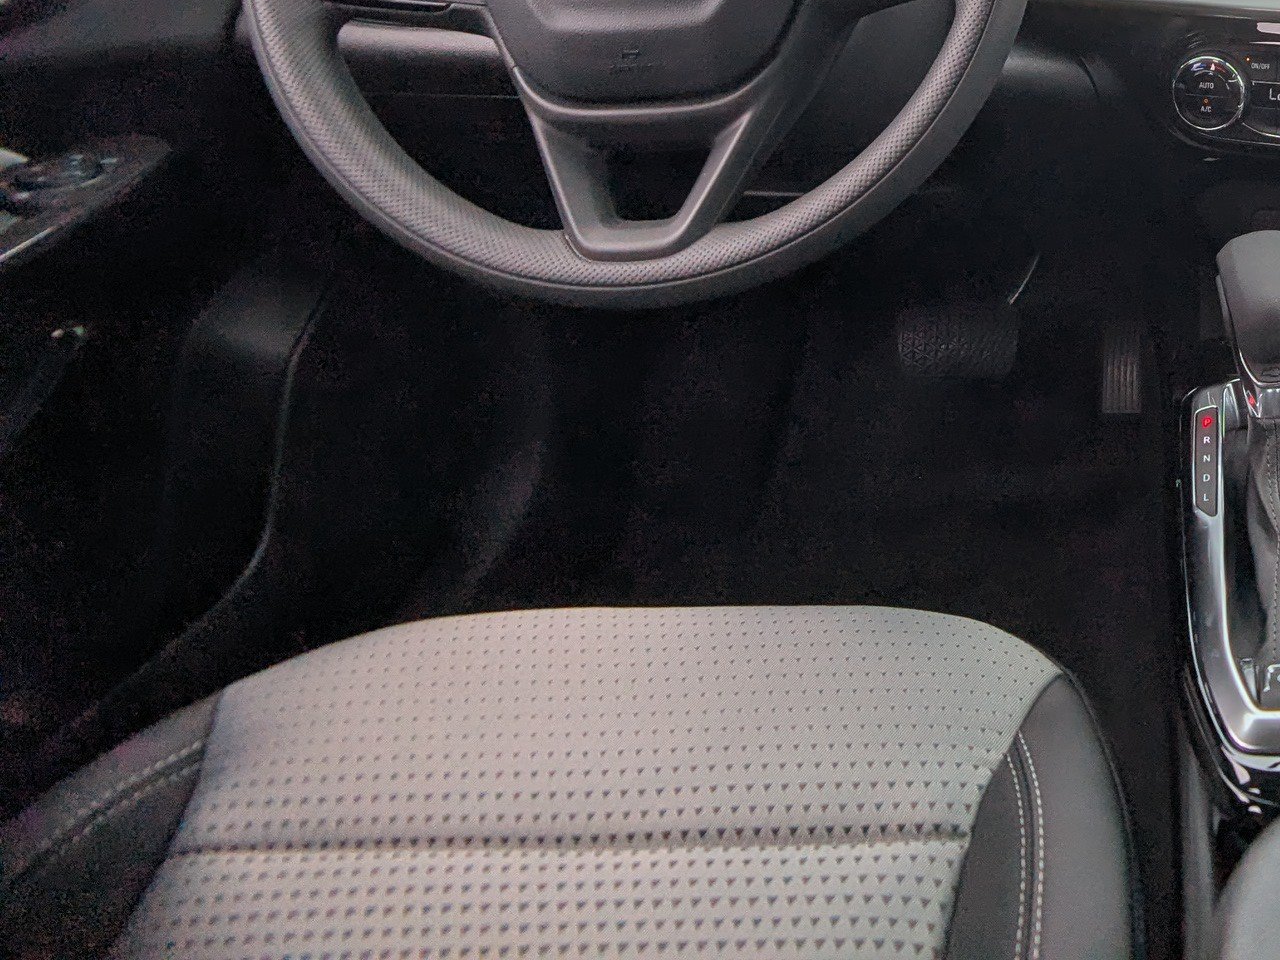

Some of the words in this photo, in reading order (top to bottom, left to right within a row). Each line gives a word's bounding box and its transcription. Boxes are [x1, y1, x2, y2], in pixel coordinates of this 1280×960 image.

[1251, 62, 1270, 70] ON/OFF
[1199, 82, 1215, 90] AUTO
[1203, 436, 1211, 444] R
[1203, 454, 1211, 463] N
[1203, 473, 1211, 482] D
[1203, 493, 1209, 502] L
